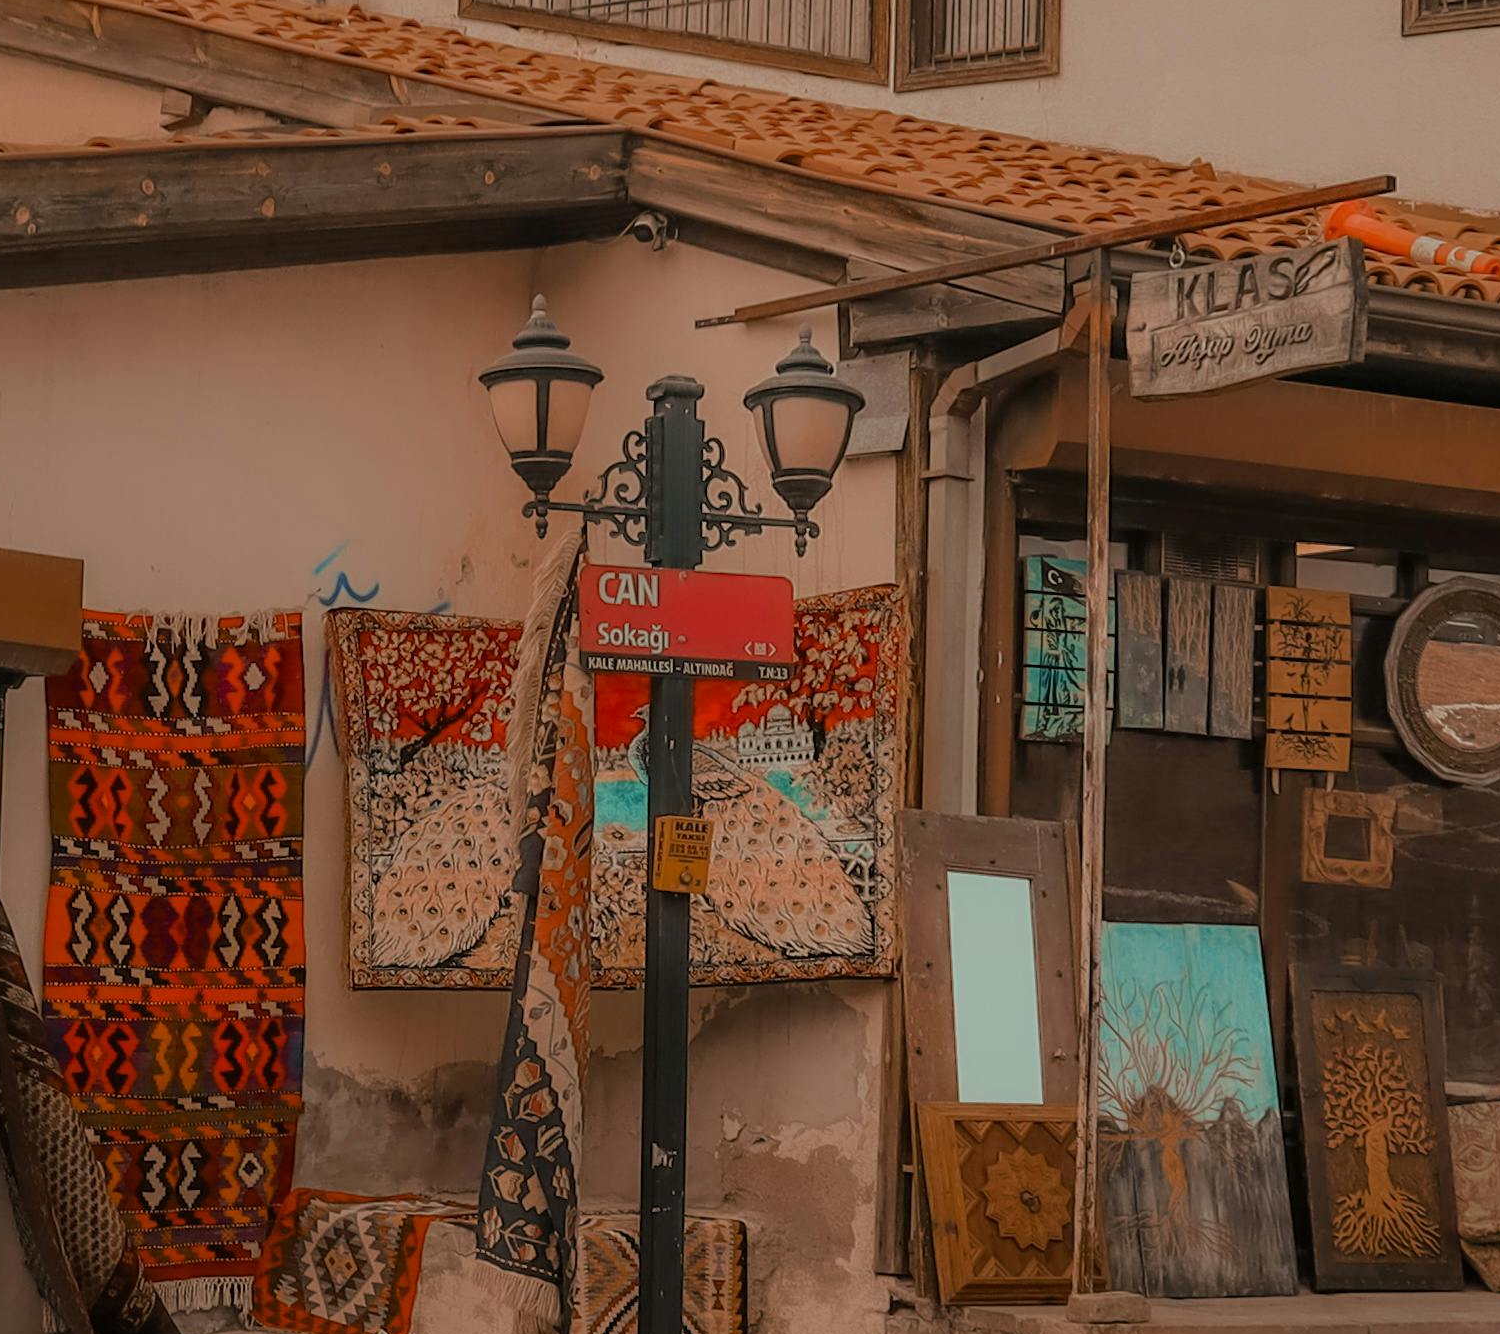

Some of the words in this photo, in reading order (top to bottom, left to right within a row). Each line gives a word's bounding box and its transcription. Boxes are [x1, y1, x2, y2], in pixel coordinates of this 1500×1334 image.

[1176, 257, 1295, 319] KLAS
[1160, 335, 1234, 368] Ahşap
[1244, 322, 1313, 363] Oyma
[598, 571, 660, 608] CAN
[597, 622, 670, 655] Sokağı
[588, 657, 614, 671] KALE
[616, 659, 674, 674] MAHALLESİ
[682, 661, 734, 677] ALTINDAĞ
[675, 821, 709, 833] KALE
